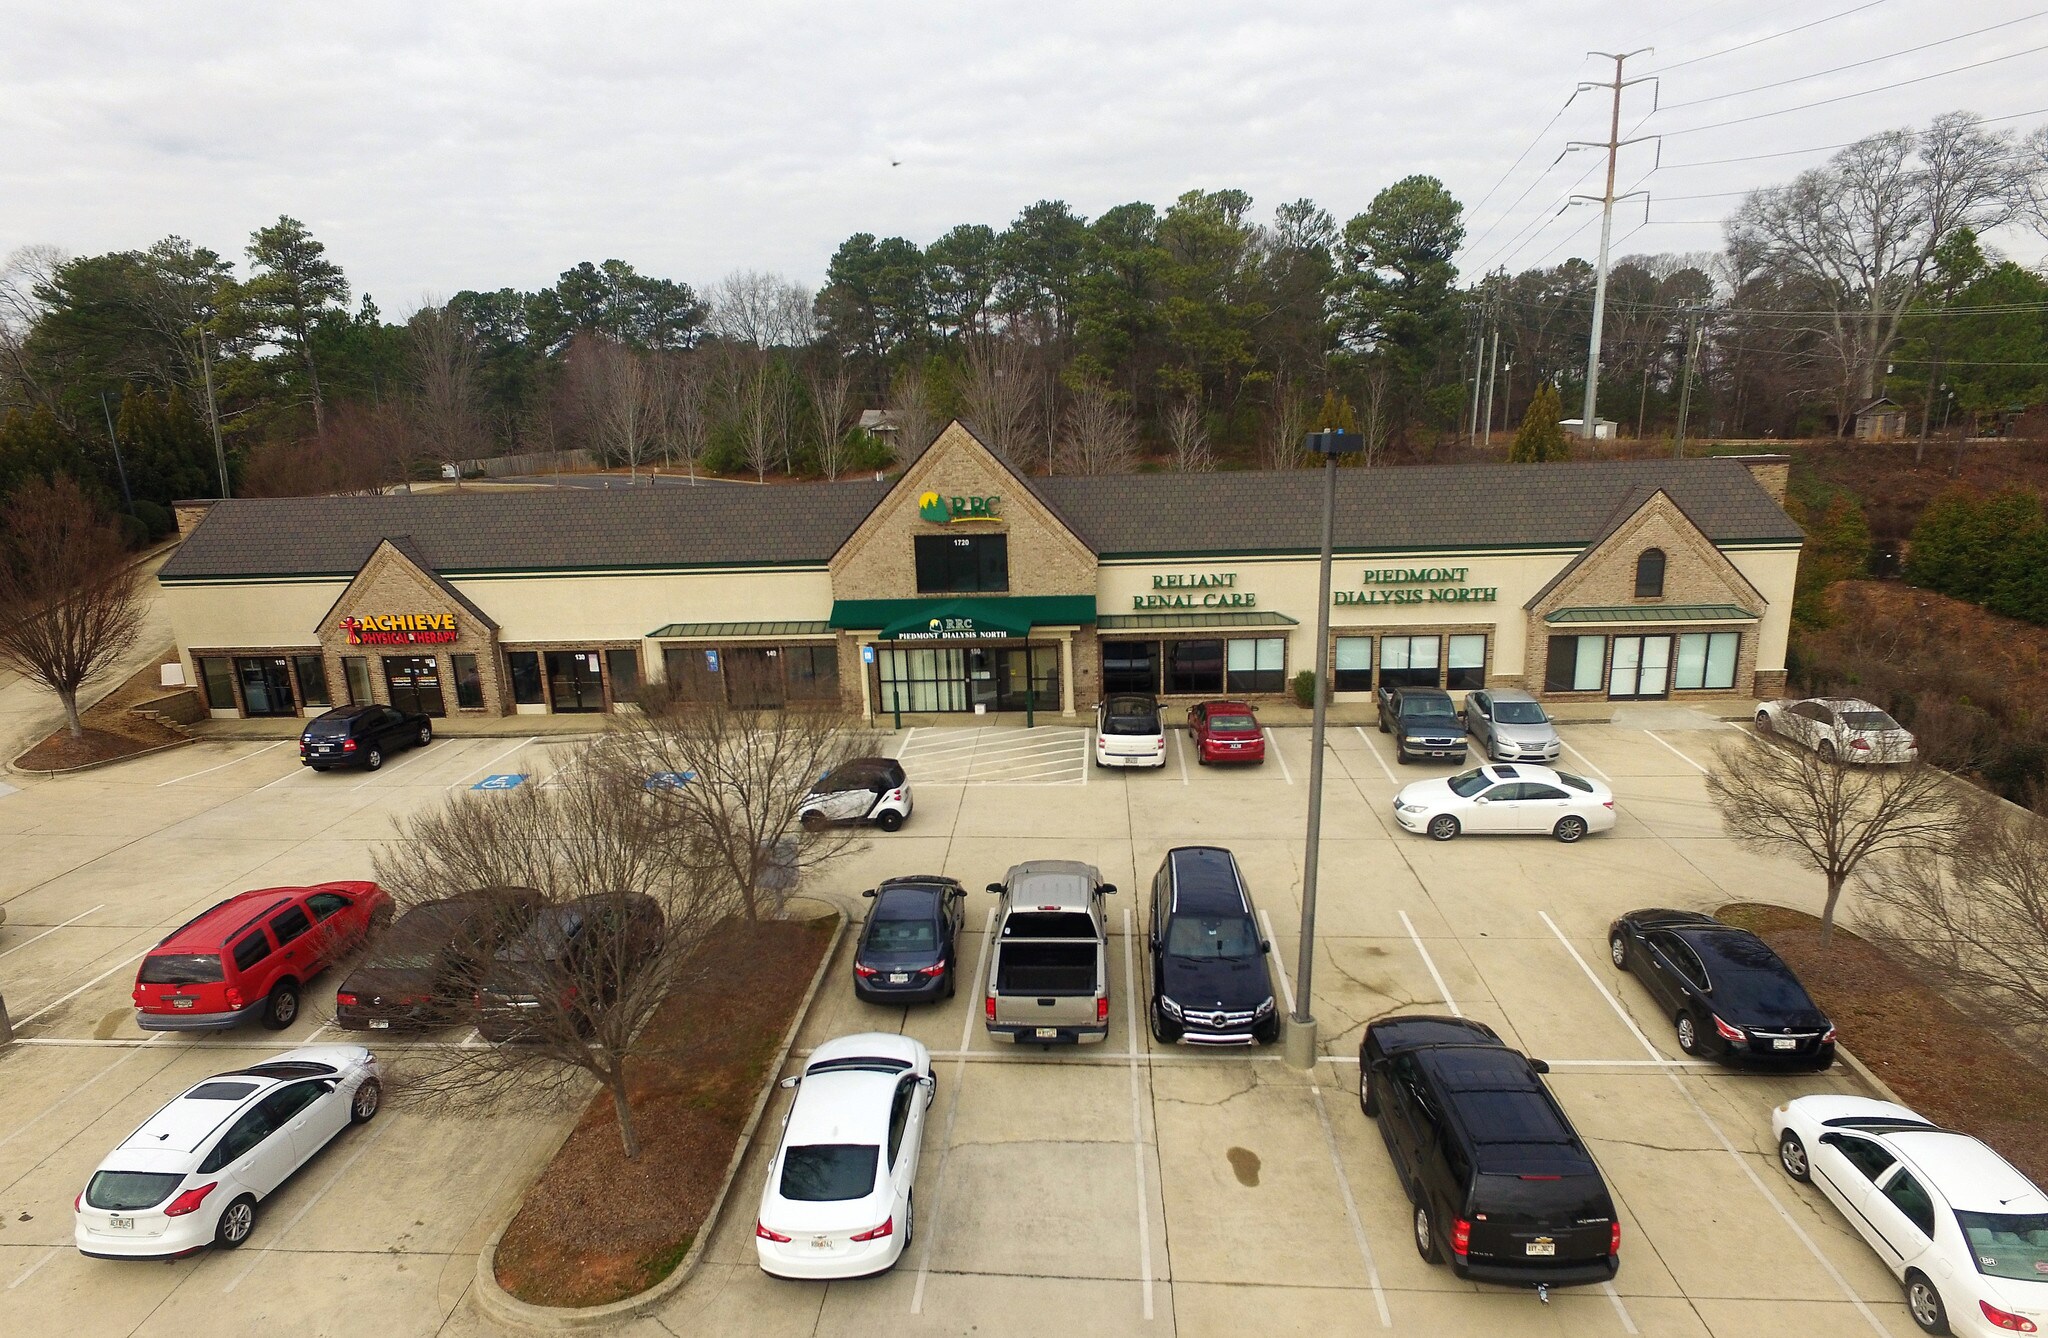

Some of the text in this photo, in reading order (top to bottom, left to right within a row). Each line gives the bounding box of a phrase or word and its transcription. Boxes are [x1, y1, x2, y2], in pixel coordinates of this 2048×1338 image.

[950, 496, 1001, 516] RRC
[1152, 573, 1237, 589] RELIANT
[1363, 567, 1469, 584] PIEDMONT
[1133, 593, 1257, 610] RENAL CARE
[1333, 587, 1498, 606] DIALYSIS NORTH
[361, 613, 456, 631] ACHIEVE
[945, 618, 973, 629] RRC
[361, 631, 457, 645] PHYSICAL THERAPY
[898, 630, 1007, 640] PIEDMONT DIALYSIS NORTH
